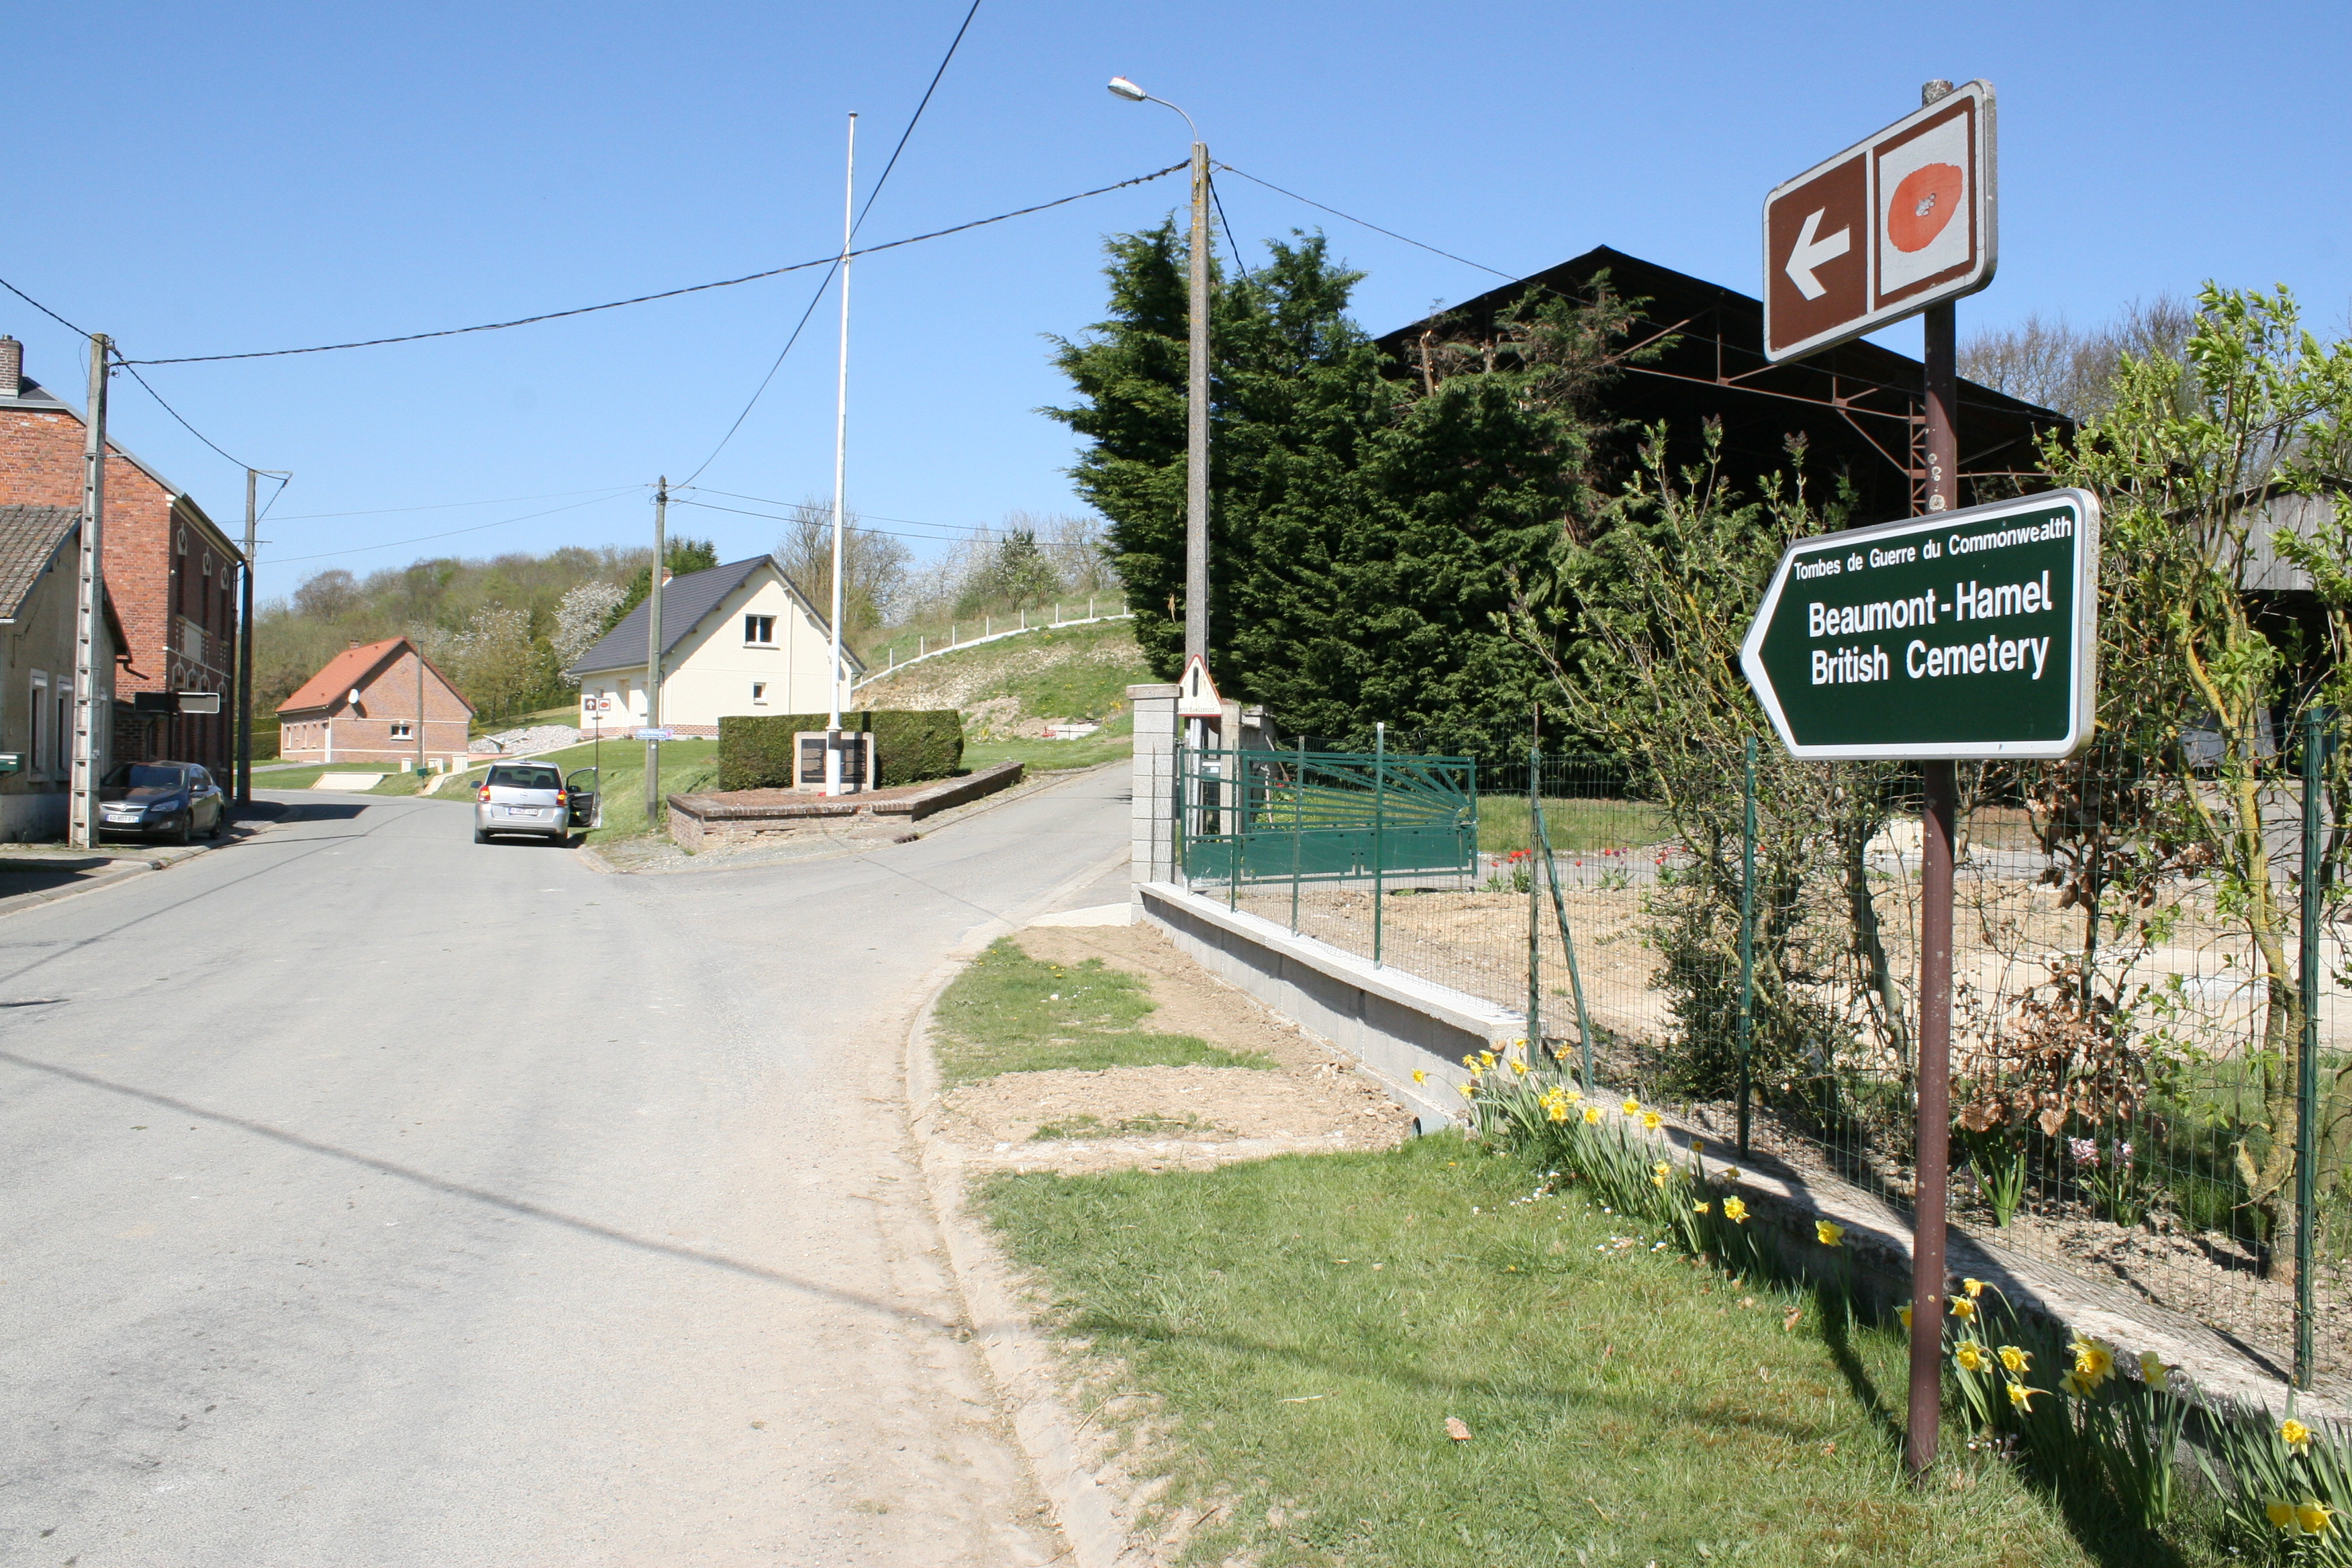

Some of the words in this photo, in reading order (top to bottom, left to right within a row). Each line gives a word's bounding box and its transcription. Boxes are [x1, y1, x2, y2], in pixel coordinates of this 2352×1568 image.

[1794, 558, 1841, 581] Tombes
[1847, 552, 1863, 572] de
[1869, 546, 1916, 569] Guerre
[1922, 538, 1941, 559] du
[1949, 516, 2072, 556] Commonwealth
[1812, 644, 1889, 685] British
[1906, 634, 2050, 681] Cemetery
